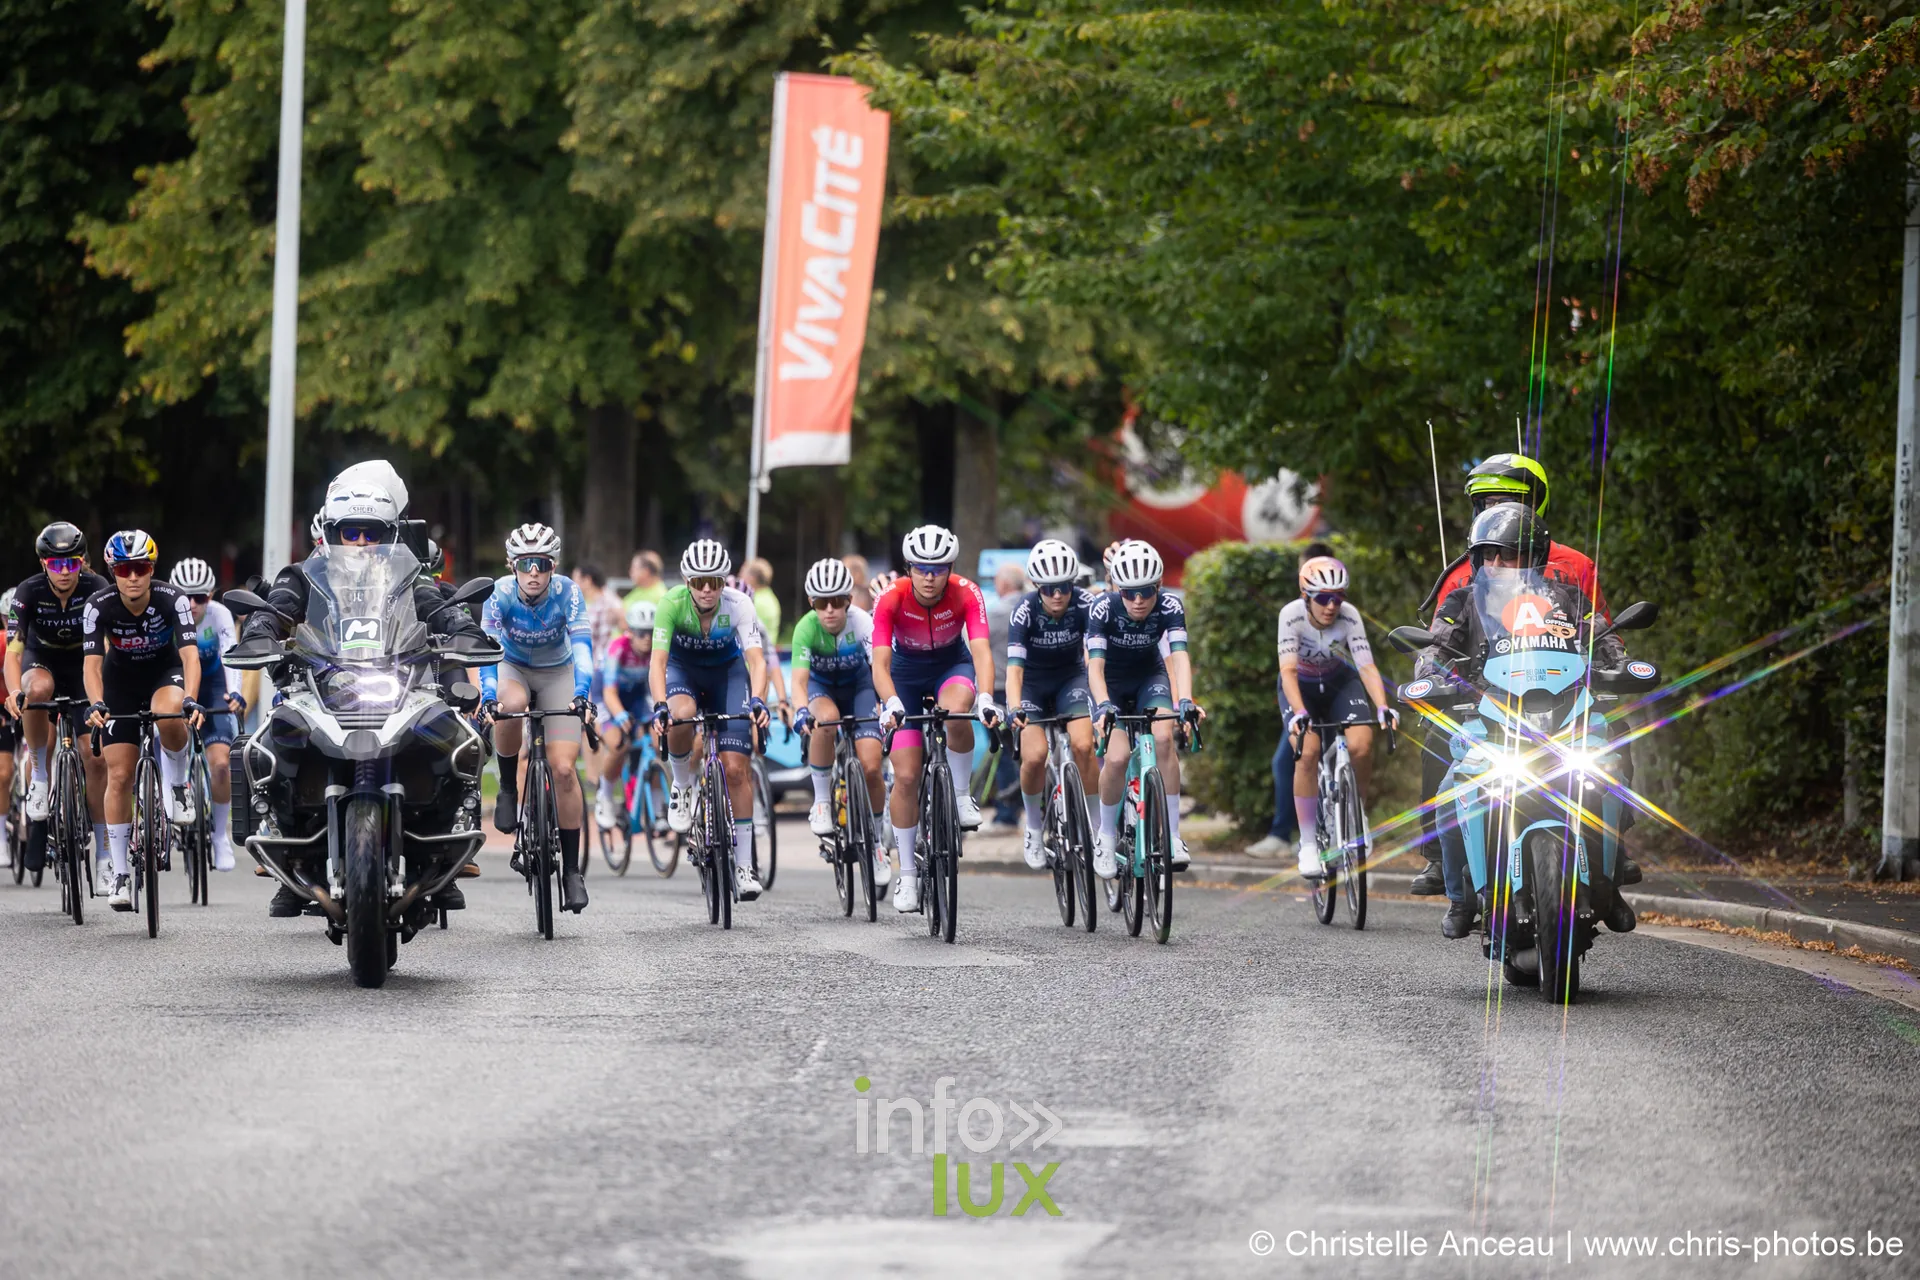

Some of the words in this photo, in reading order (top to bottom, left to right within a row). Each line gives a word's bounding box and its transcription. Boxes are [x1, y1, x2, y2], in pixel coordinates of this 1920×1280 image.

[36, 616, 84, 627] CITYMES
[1512, 602, 1546, 630] A
[1545, 619, 1575, 629] OFFICIEL
[1029, 631, 1080, 645] FREELANCERS
[1043, 629, 1070, 639] FLYING
[121, 636, 149, 647] FDJ
[1511, 636, 1568, 649] YAMAHA
